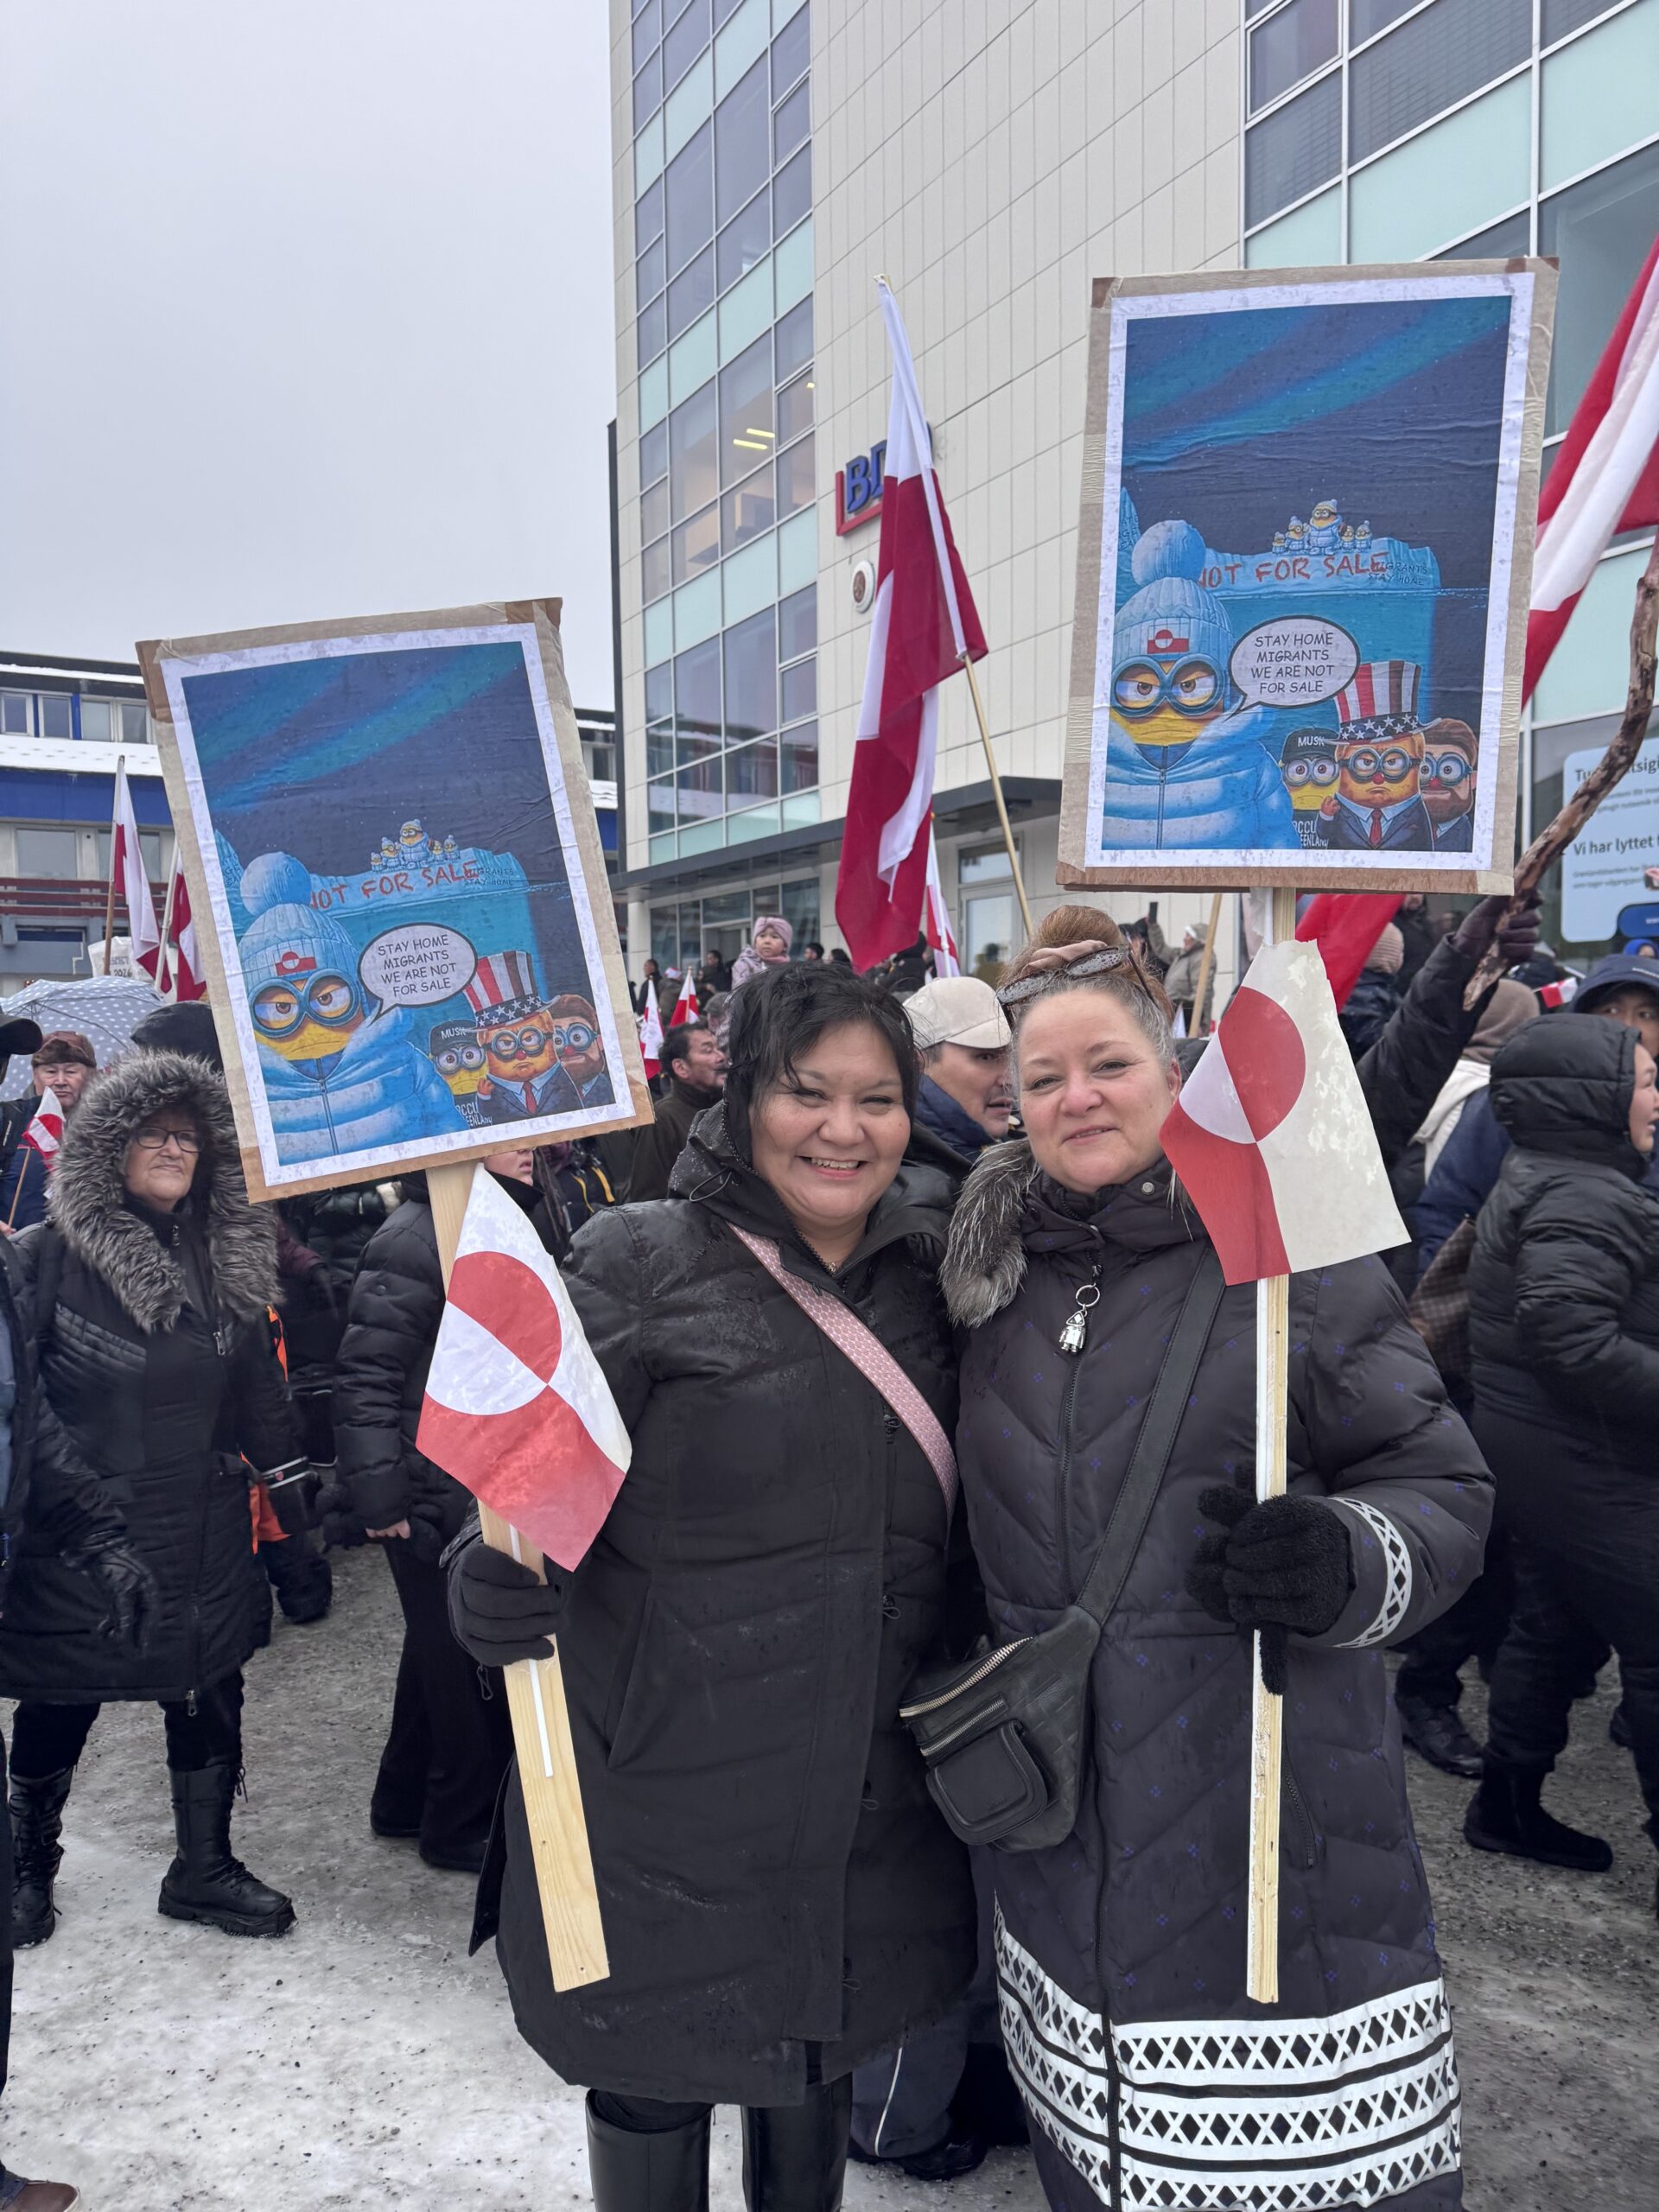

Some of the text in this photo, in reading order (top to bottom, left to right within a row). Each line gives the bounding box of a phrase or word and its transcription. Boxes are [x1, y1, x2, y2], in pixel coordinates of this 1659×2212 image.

[1255, 557, 1311, 582] FOR
[1324, 551, 1389, 578] SALE
[1255, 632, 1334, 647] STAY HOME
[1256, 649, 1330, 664] MIGRANTS
[1250, 664, 1335, 678] WE ARE NOT
[1260, 680, 1324, 695] FOR SALE
[1573, 836, 1654, 855] Vi har lyttet
[361, 872, 414, 899] FOR
[422, 860, 480, 887] SALE
[378, 934, 449, 956] STAY HOME
[384, 950, 449, 970] MIGRANTS
[381, 963, 456, 984] WE ARE NOT
[393, 977, 452, 997] FOR SALE
